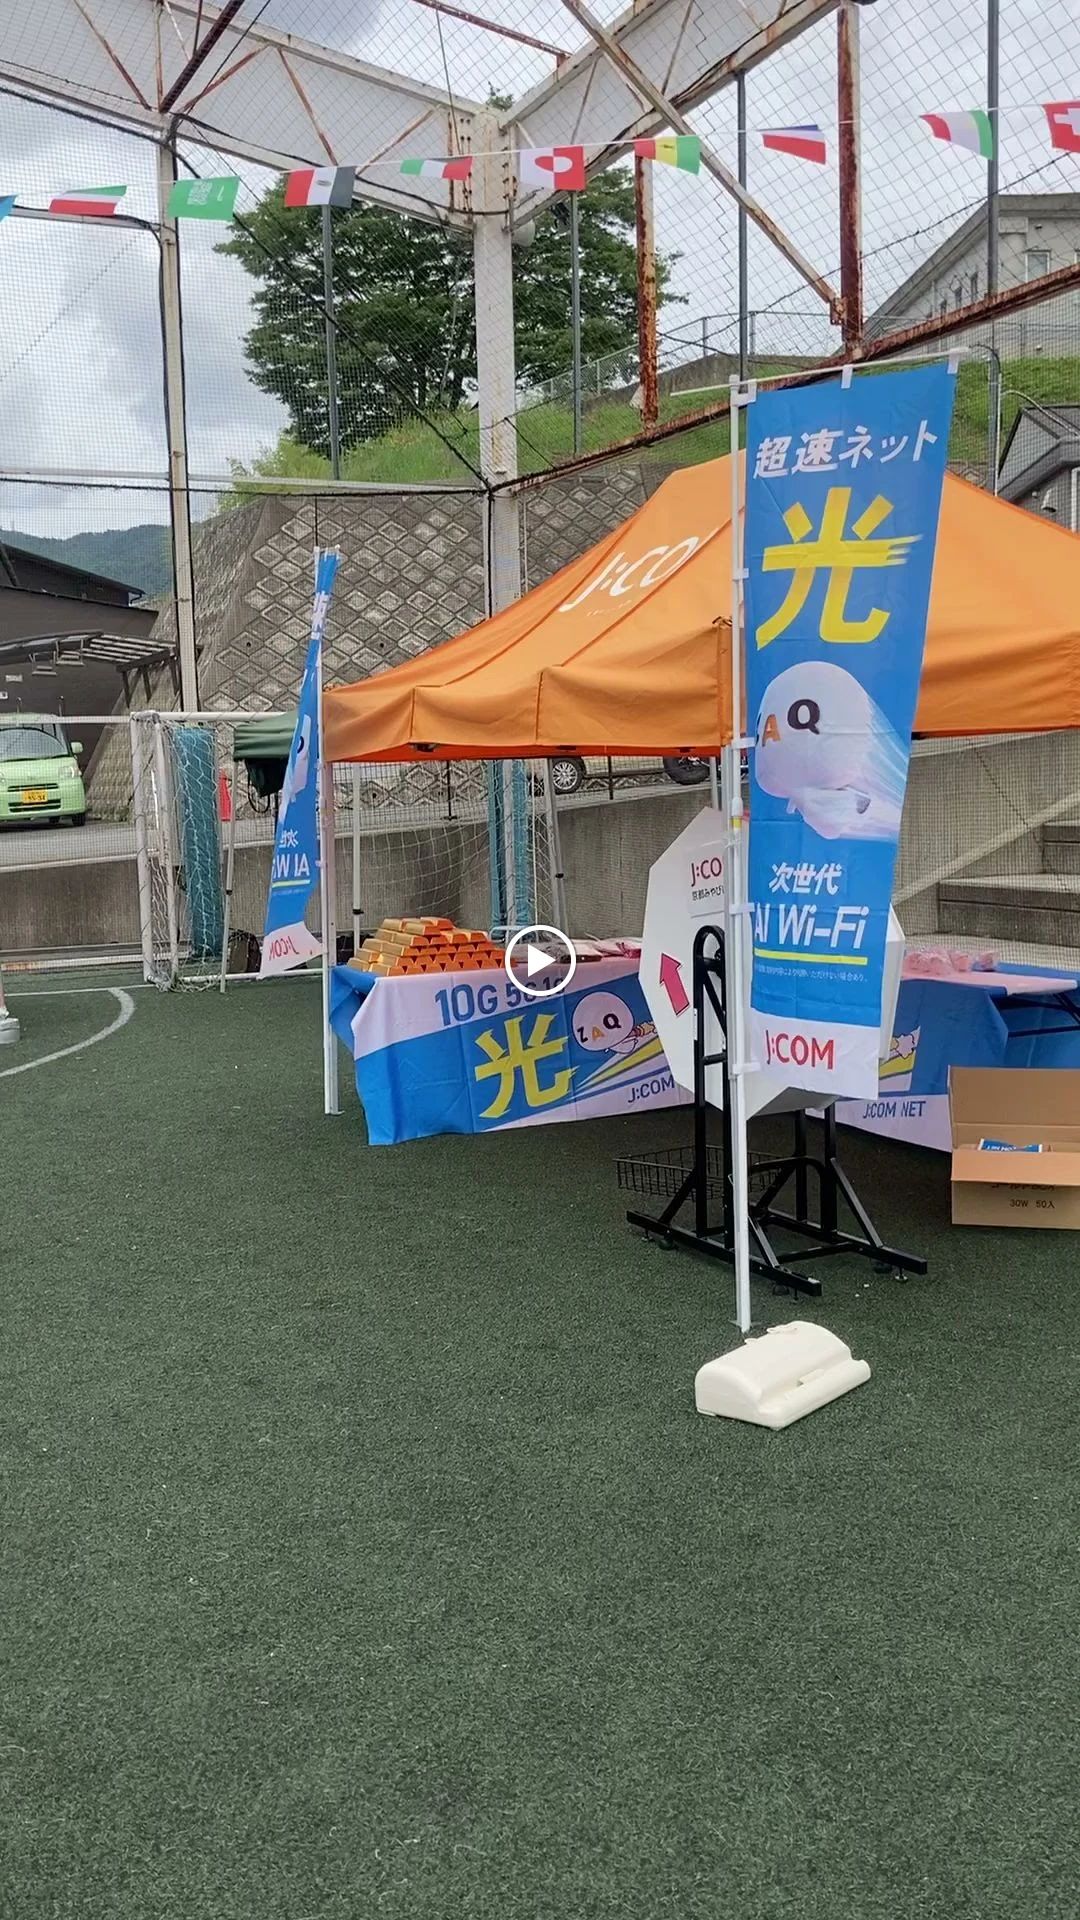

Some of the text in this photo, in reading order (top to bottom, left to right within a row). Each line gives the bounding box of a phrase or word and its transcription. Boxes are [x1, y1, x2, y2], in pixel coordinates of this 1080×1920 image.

[753, 419, 939, 480] 超速ネット
[755, 486, 924, 651] 光
[768, 862, 843, 896] 次世代
[778, 903, 870, 949] Wi-Fi
[435, 982, 498, 1026] 10G
[577, 1013, 622, 1043] ZAQ
[474, 1013, 579, 1119] 光
[765, 1029, 835, 1070] J:COM
[627, 1074, 675, 1103] J:COM
[862, 1101, 926, 1119] J:COM NET
